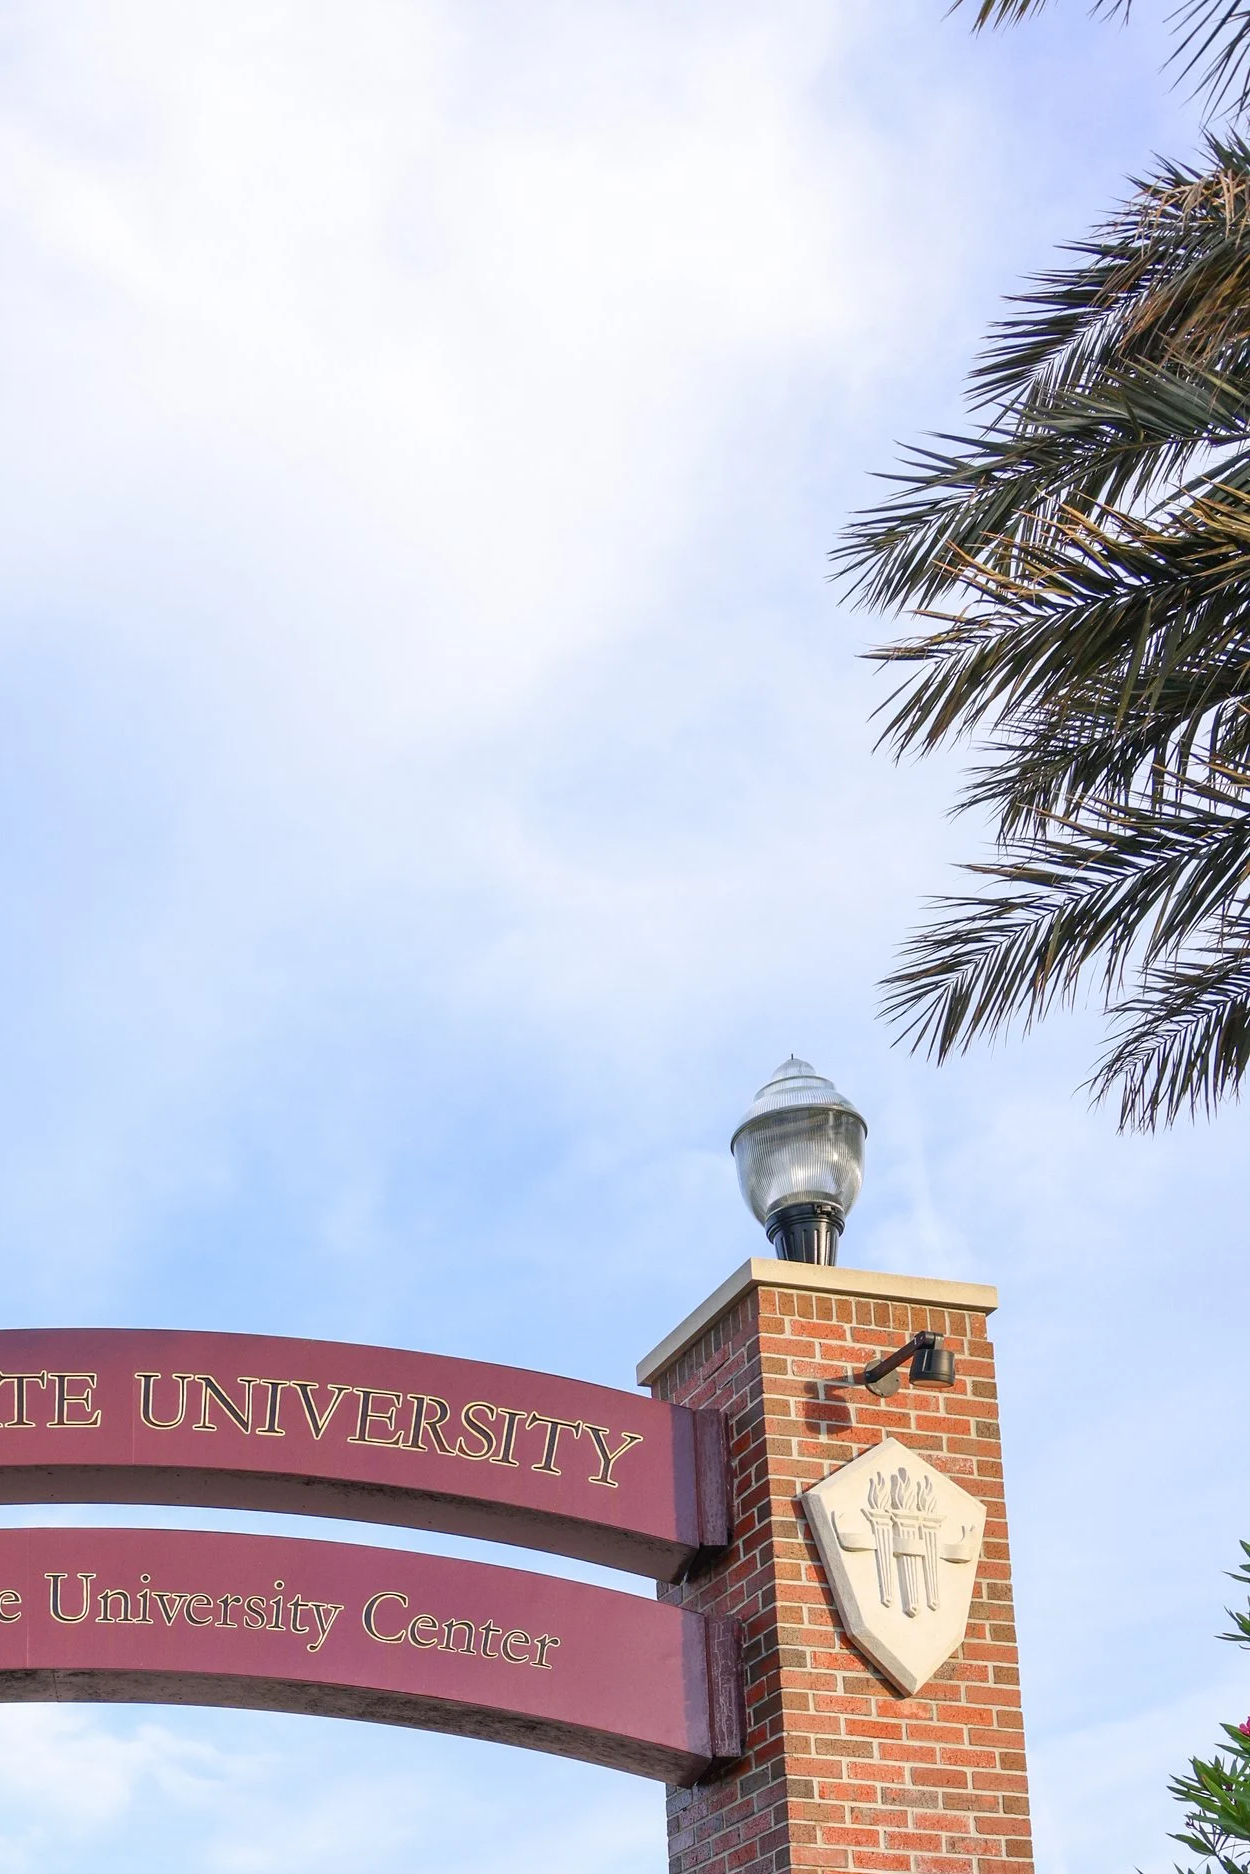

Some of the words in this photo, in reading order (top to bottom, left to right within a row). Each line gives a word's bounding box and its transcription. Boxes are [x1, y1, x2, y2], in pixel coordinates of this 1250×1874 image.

[134, 1372, 643, 1488] UNIVERSITY
[44, 1573, 344, 1652] University
[362, 1591, 560, 1669] Center
